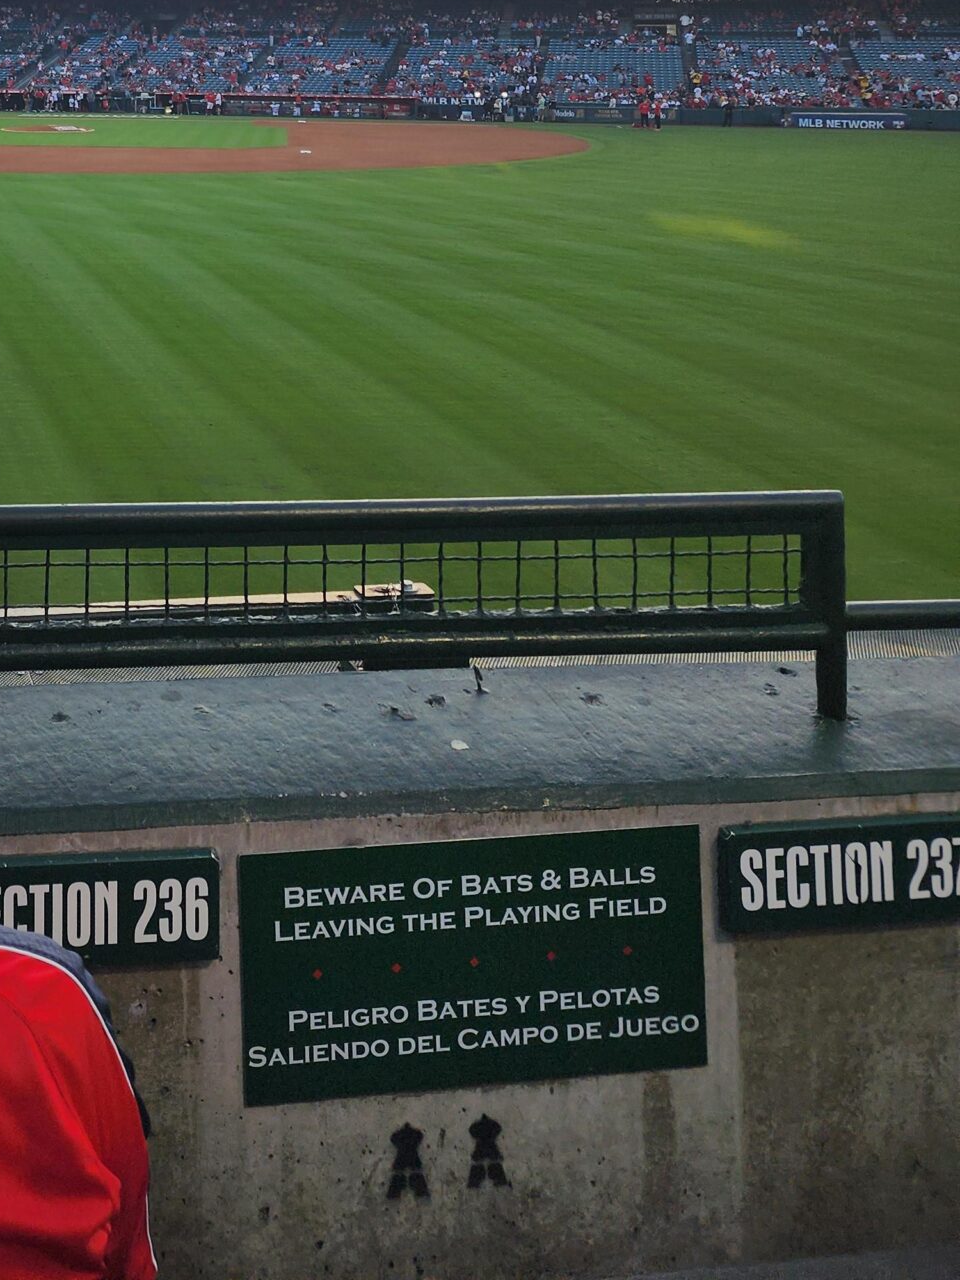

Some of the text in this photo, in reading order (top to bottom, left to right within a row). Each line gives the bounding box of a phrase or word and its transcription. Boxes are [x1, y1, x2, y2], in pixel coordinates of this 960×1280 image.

[798, 118, 823, 128] MLB
[826, 120, 884, 129] NETWORK
[540, 869, 562, 891] &
[740, 841, 895, 911] SECTION
[133, 877, 209, 943] 236
[402, 911, 457, 933] THE
[398, 1035, 450, 1056] DEL
[566, 1022, 602, 1042] DE
